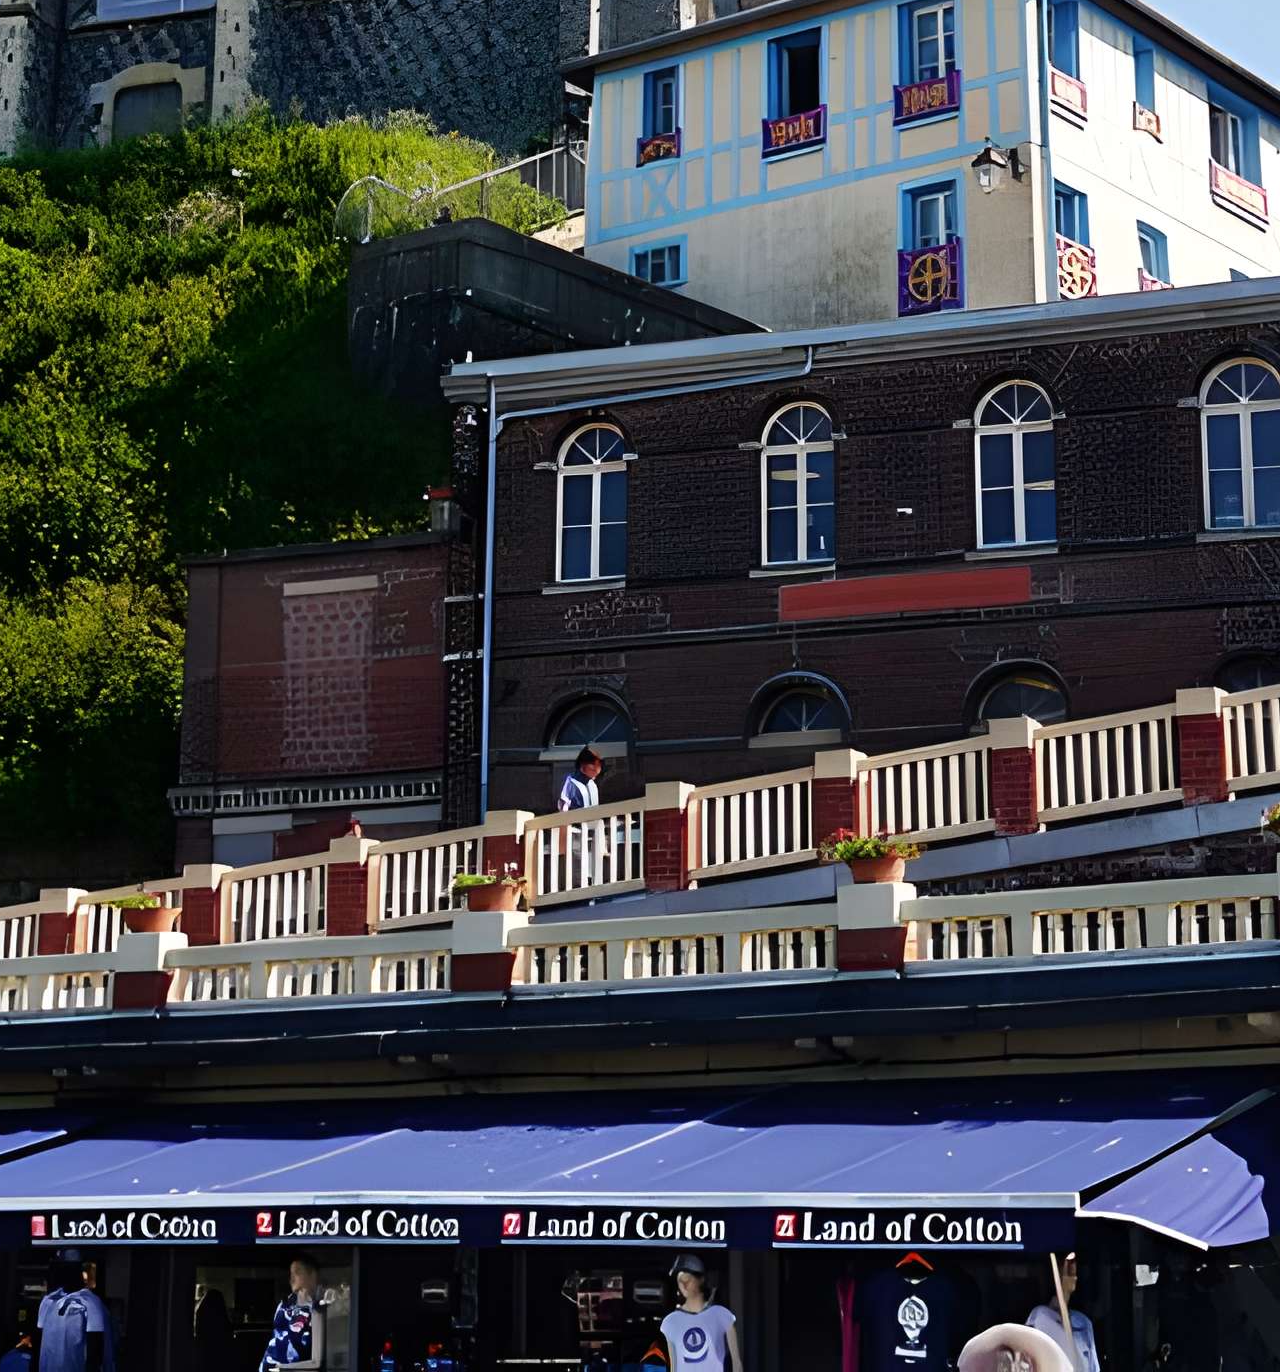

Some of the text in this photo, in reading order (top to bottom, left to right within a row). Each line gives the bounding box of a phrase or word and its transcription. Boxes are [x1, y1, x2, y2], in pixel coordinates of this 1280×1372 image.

[278, 1210, 459, 1237] Land of Cotton
[527, 1211, 726, 1240] Land of Cotton
[802, 1212, 1022, 1242] Land of Cotton
